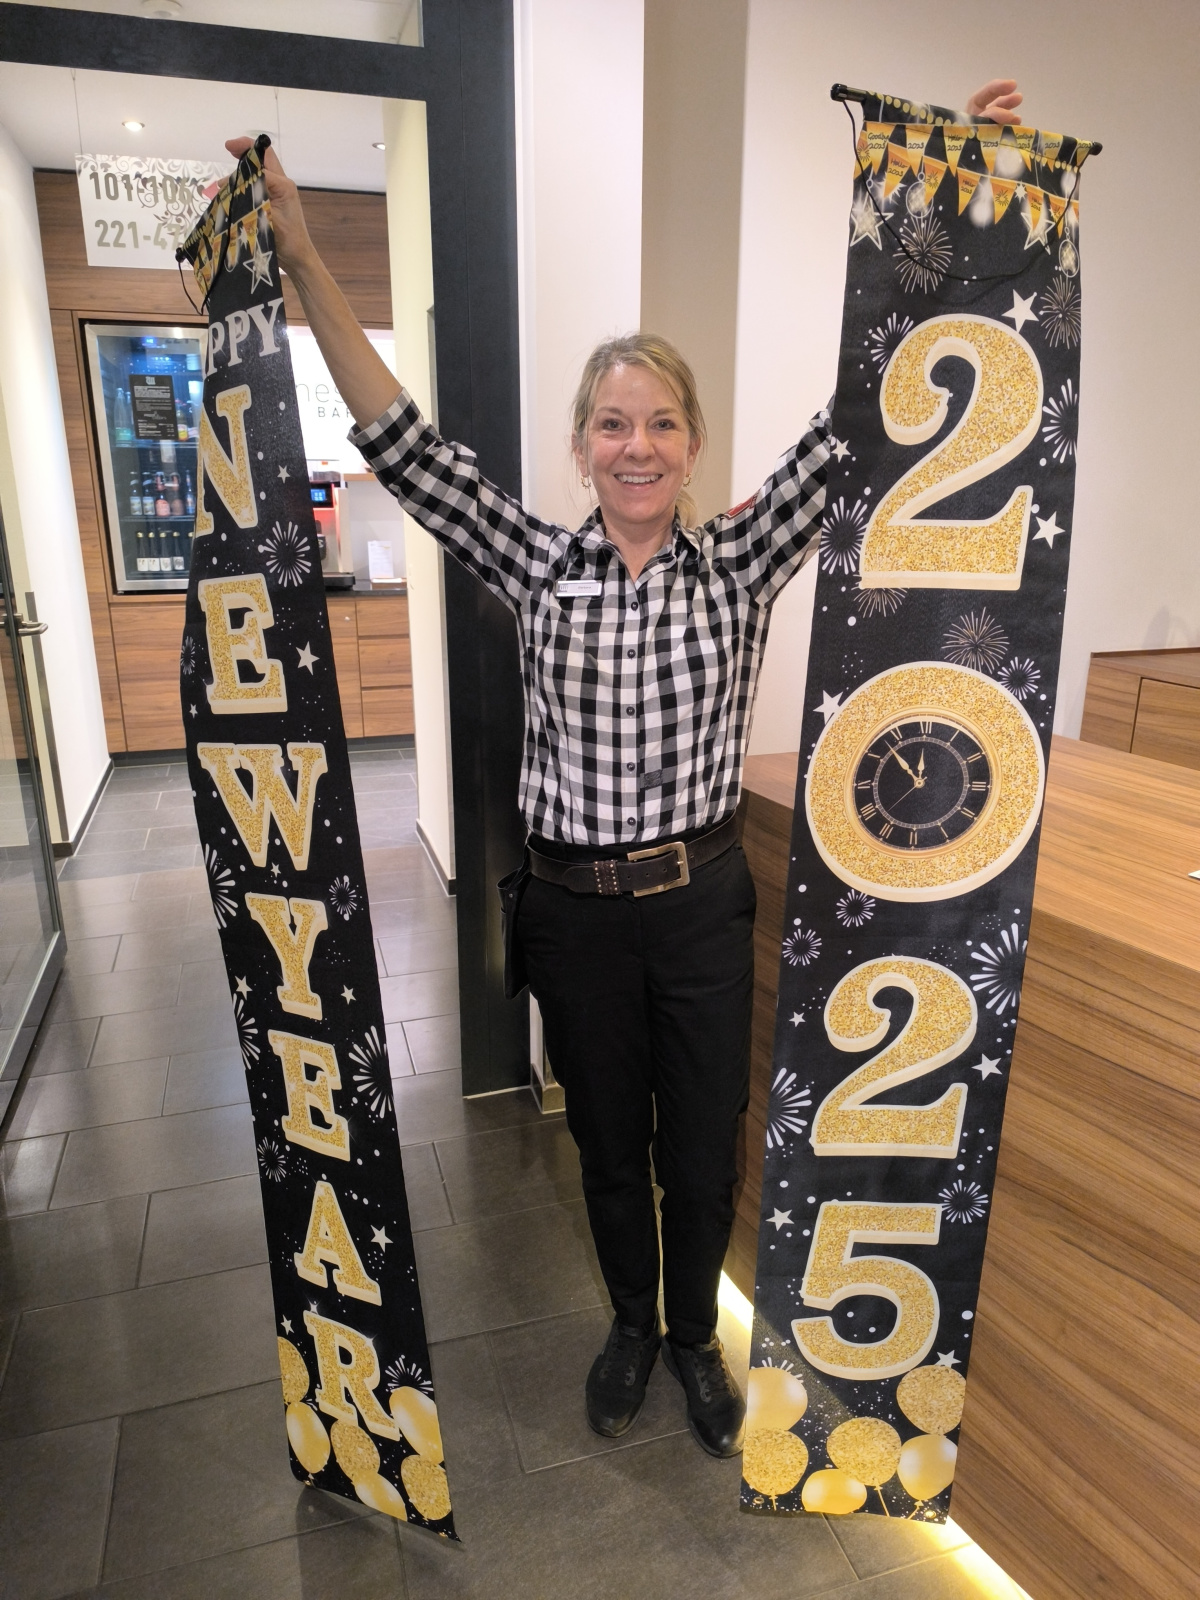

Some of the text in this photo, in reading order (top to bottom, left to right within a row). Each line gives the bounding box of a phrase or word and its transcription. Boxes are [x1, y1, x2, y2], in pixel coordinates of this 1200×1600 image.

[89, 171, 192, 205] 101-106
[94, 219, 190, 251] 221-47
[205, 298, 283, 378] PPY
[791, 313, 1046, 1382] 2025
[244, 892, 400, 1441] YEAR
